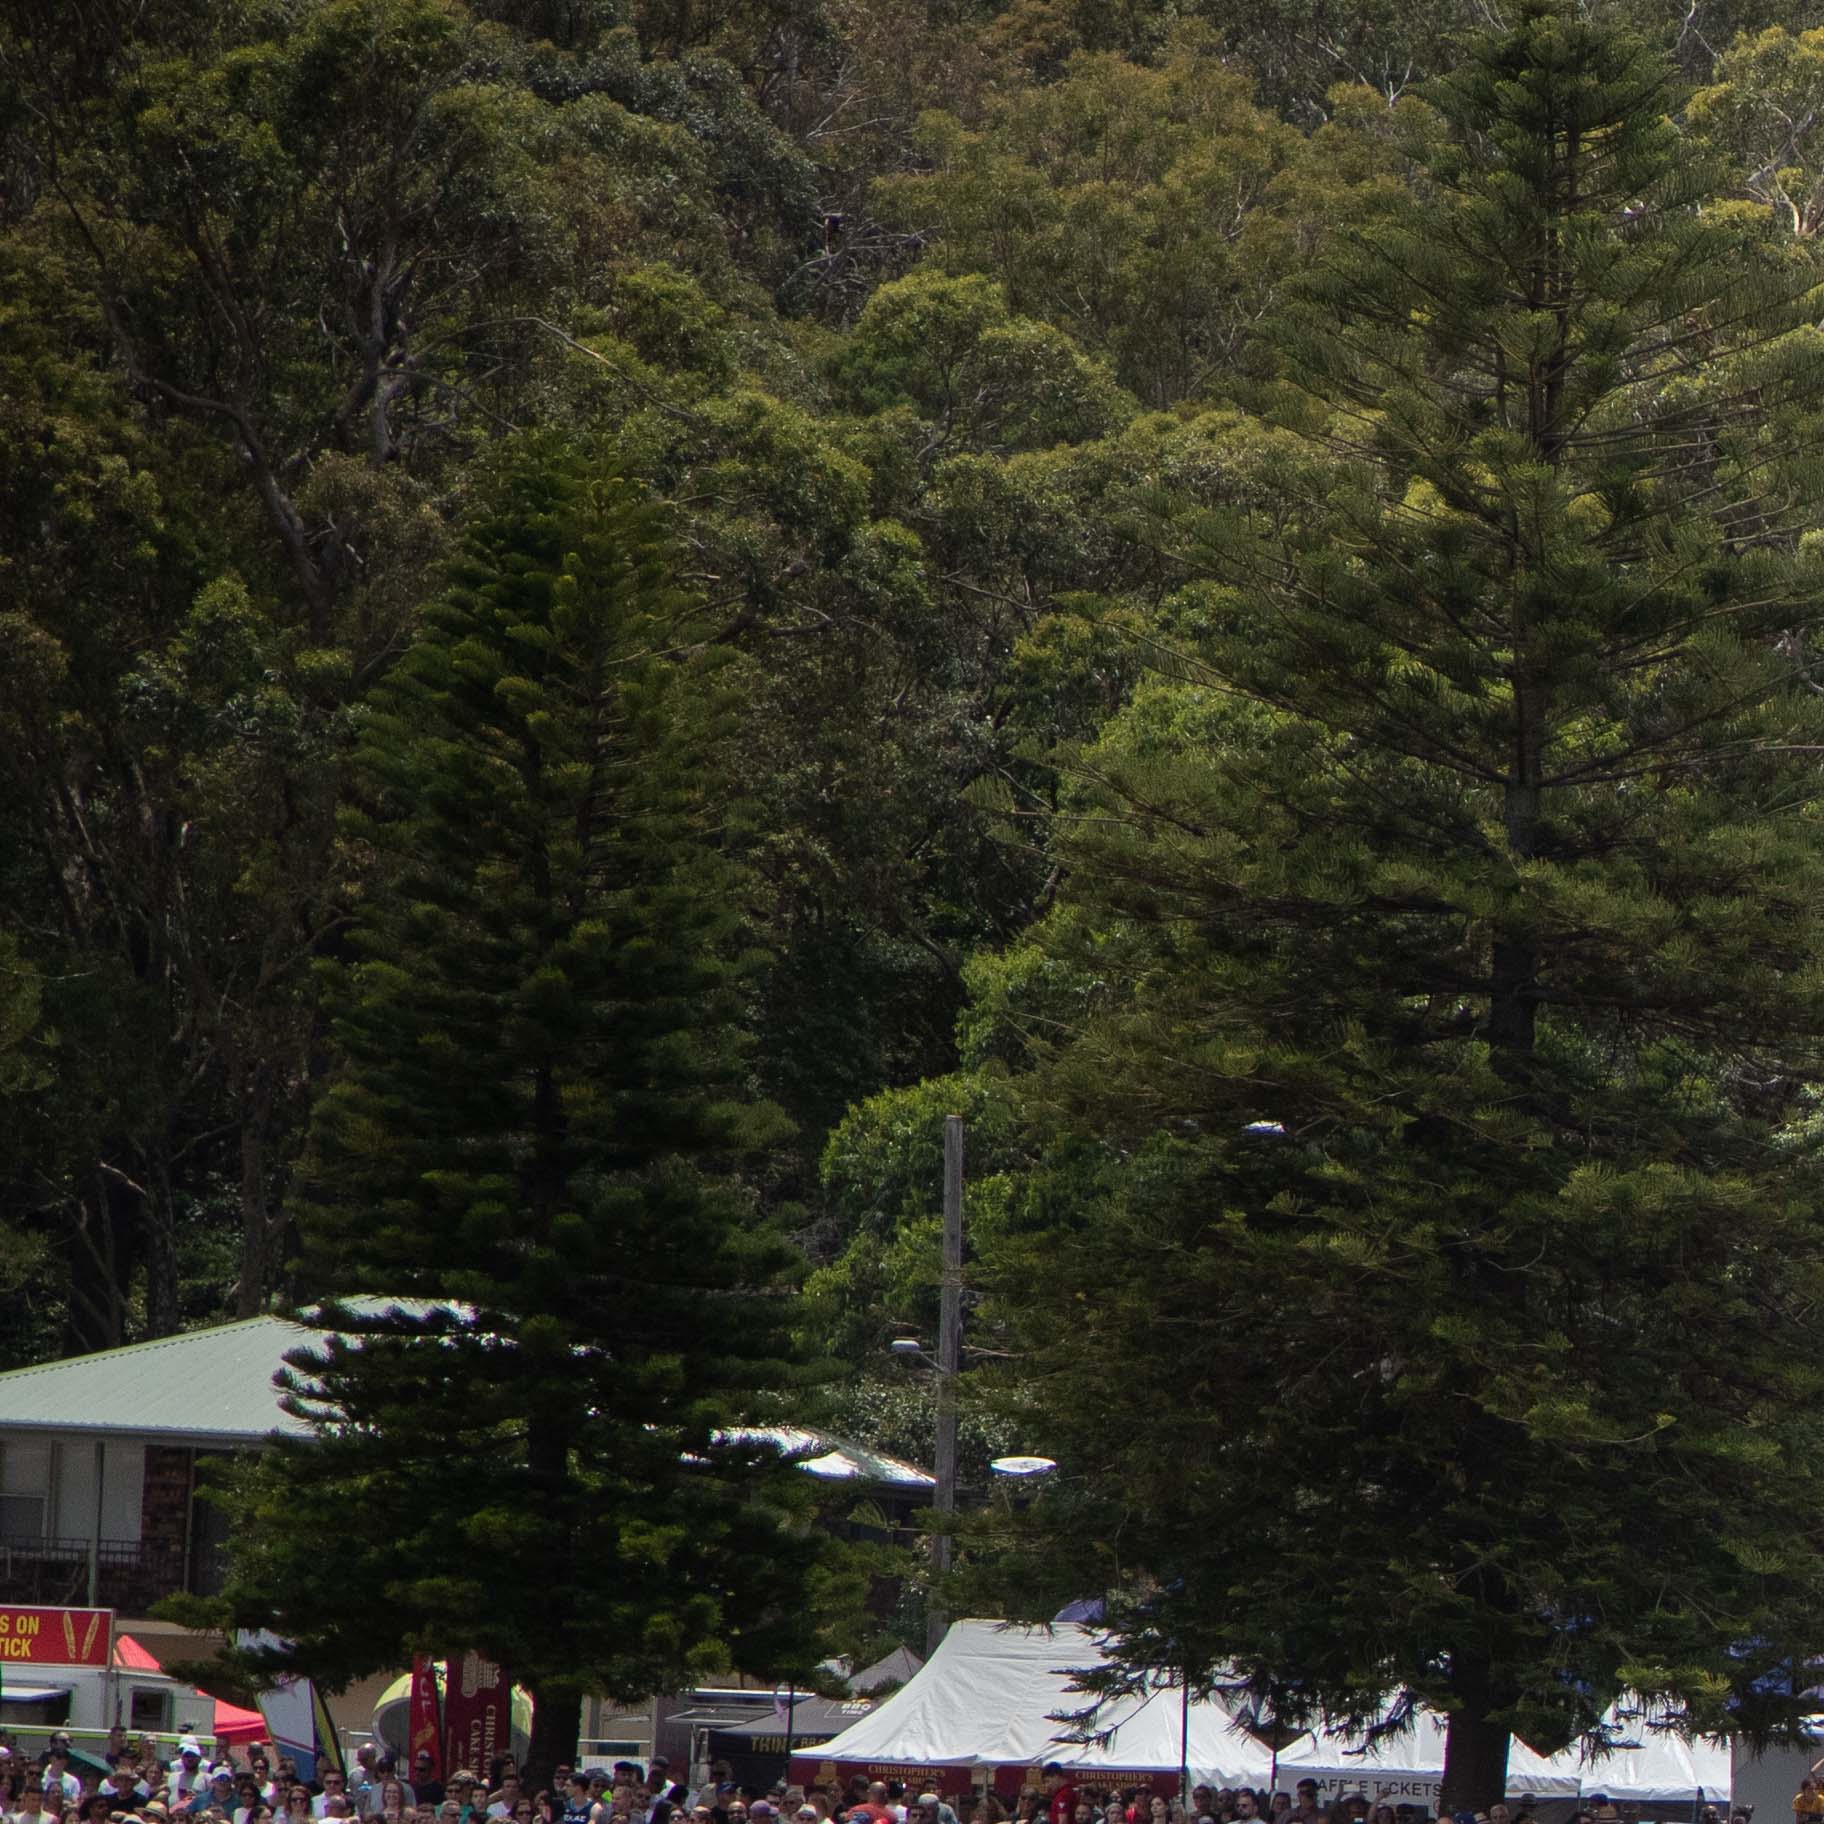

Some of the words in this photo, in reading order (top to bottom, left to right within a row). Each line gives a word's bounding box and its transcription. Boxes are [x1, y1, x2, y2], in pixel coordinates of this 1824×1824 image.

[0, 1615, 10, 1634] S
[16, 1615, 40, 1635] ON
[0, 1637, 32, 1657] TICK
[1374, 1780, 1442, 1797] TCKETS
